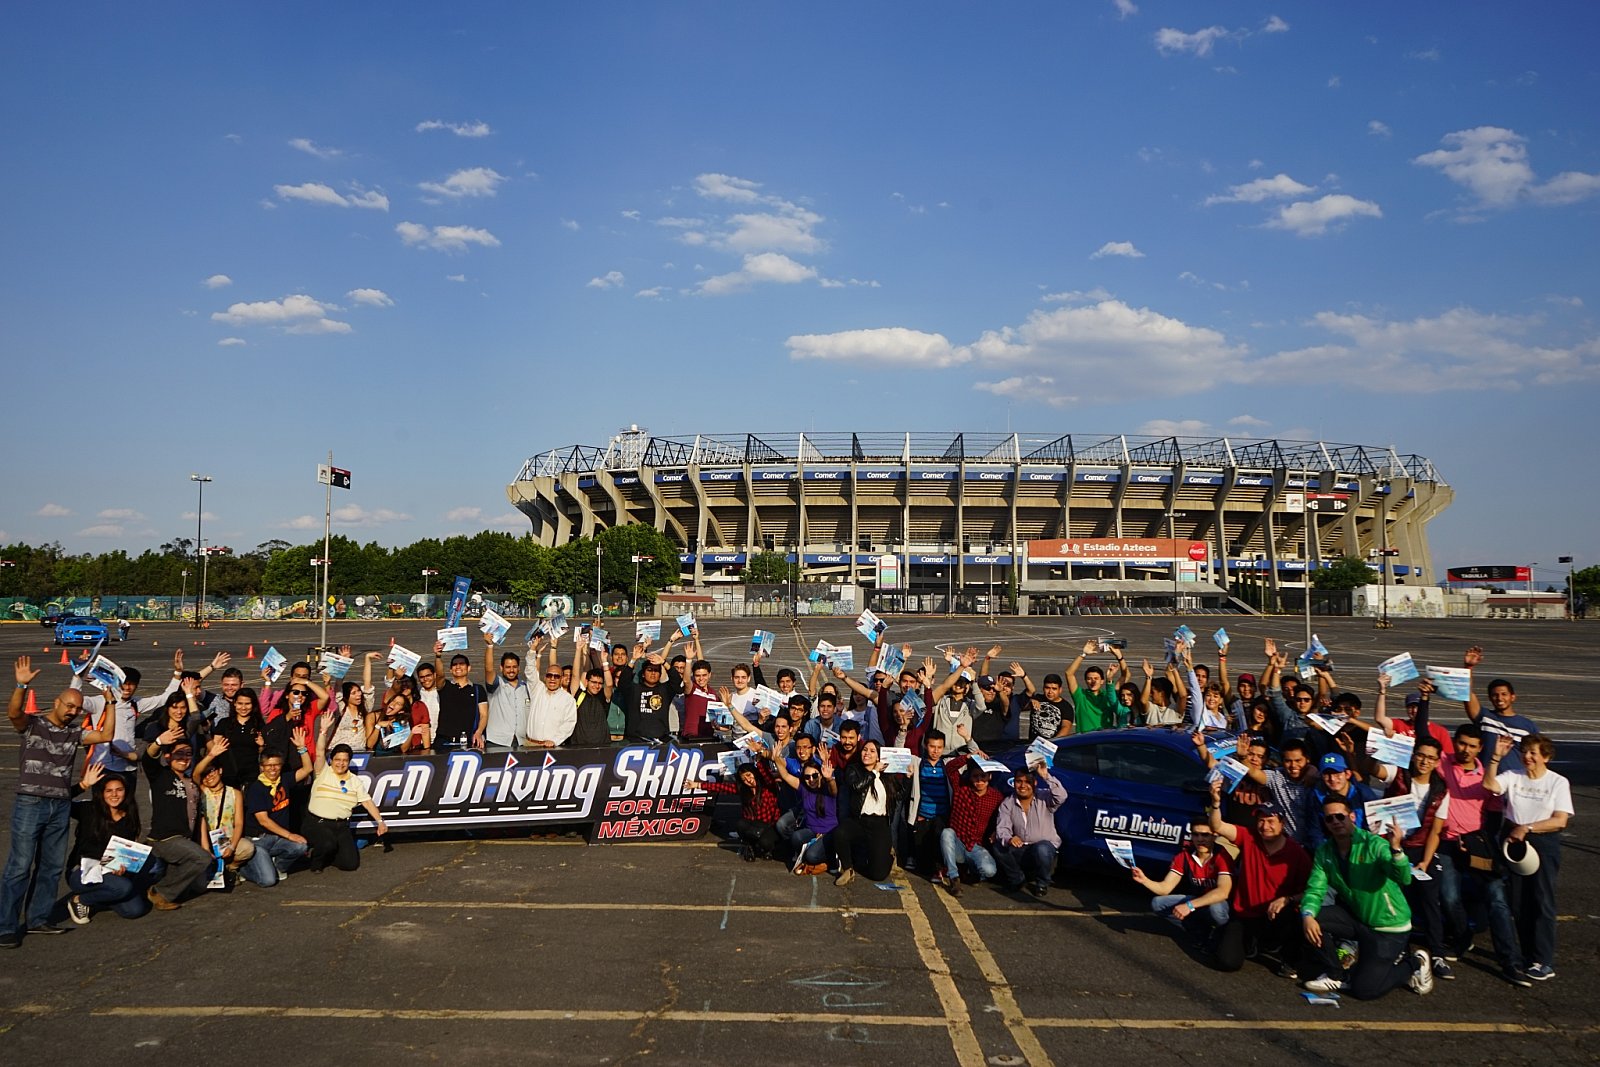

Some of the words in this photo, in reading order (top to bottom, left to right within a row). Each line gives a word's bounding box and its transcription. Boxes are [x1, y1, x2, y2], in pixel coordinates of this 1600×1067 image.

[1312, 501, 1318, 509] G
[1334, 500, 1341, 509] H
[1122, 543, 1157, 552] Azteca
[438, 752, 603, 818] Driving
[604, 799, 653, 816] FOR
[656, 797, 706, 813] LIFE
[598, 816, 700, 839] MÉXICO
[1130, 814, 1182, 844] Driving
